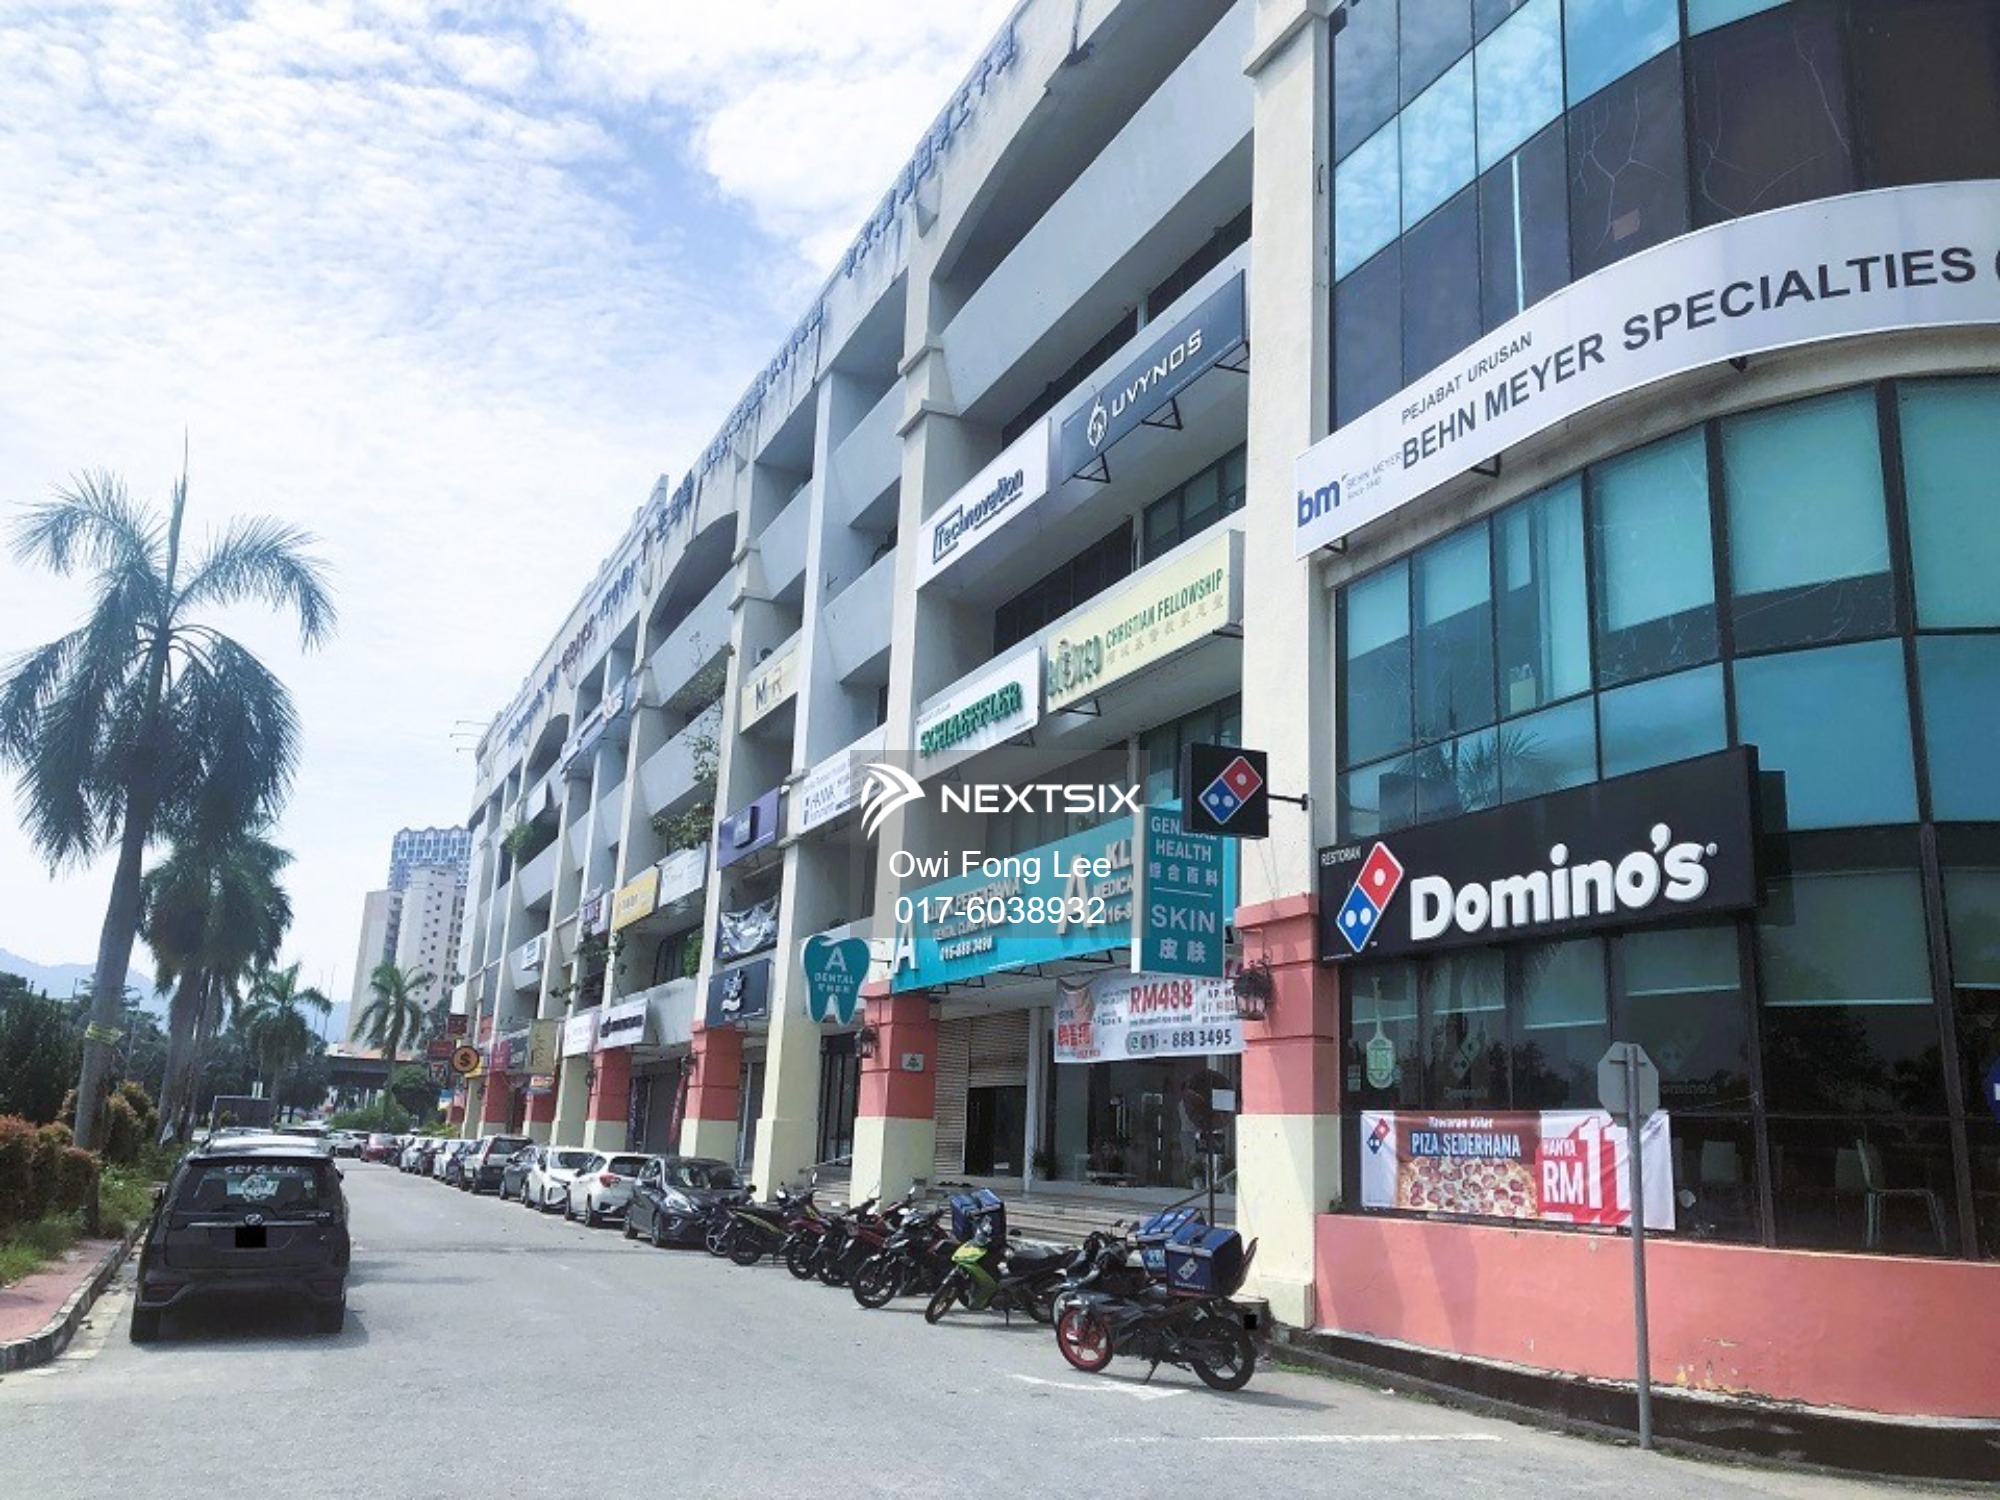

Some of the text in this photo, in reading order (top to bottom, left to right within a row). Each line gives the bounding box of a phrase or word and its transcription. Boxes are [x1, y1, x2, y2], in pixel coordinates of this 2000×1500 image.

[1402, 246, 1976, 470] BEHN MEYER SPECIALTIES
[1111, 328, 1202, 417] UVYNOS
[1401, 331, 1533, 425] PEJABAT URUSAN
[1297, 480, 1340, 527] bm
[1105, 605, 1155, 649] CHRISTIAN
[1157, 568, 1224, 622] FELLOWSHIP
[1155, 838, 1212, 863] HEALTH
[1321, 846, 1361, 867] RESTORAN
[1410, 823, 1709, 942] Domino's
[1151, 903, 1215, 934] SKIN
[825, 946, 847, 972] A
[814, 972, 855, 984] DENTAL
[1129, 978, 1193, 1014] RM488
[1199, 1028, 1233, 1047] 3495
[1427, 1116, 1494, 1129] Tawaran Kilat
[1411, 1131, 1521, 1157] PIZA SEDERHANA
[1541, 1137, 1577, 1157] HANYA
